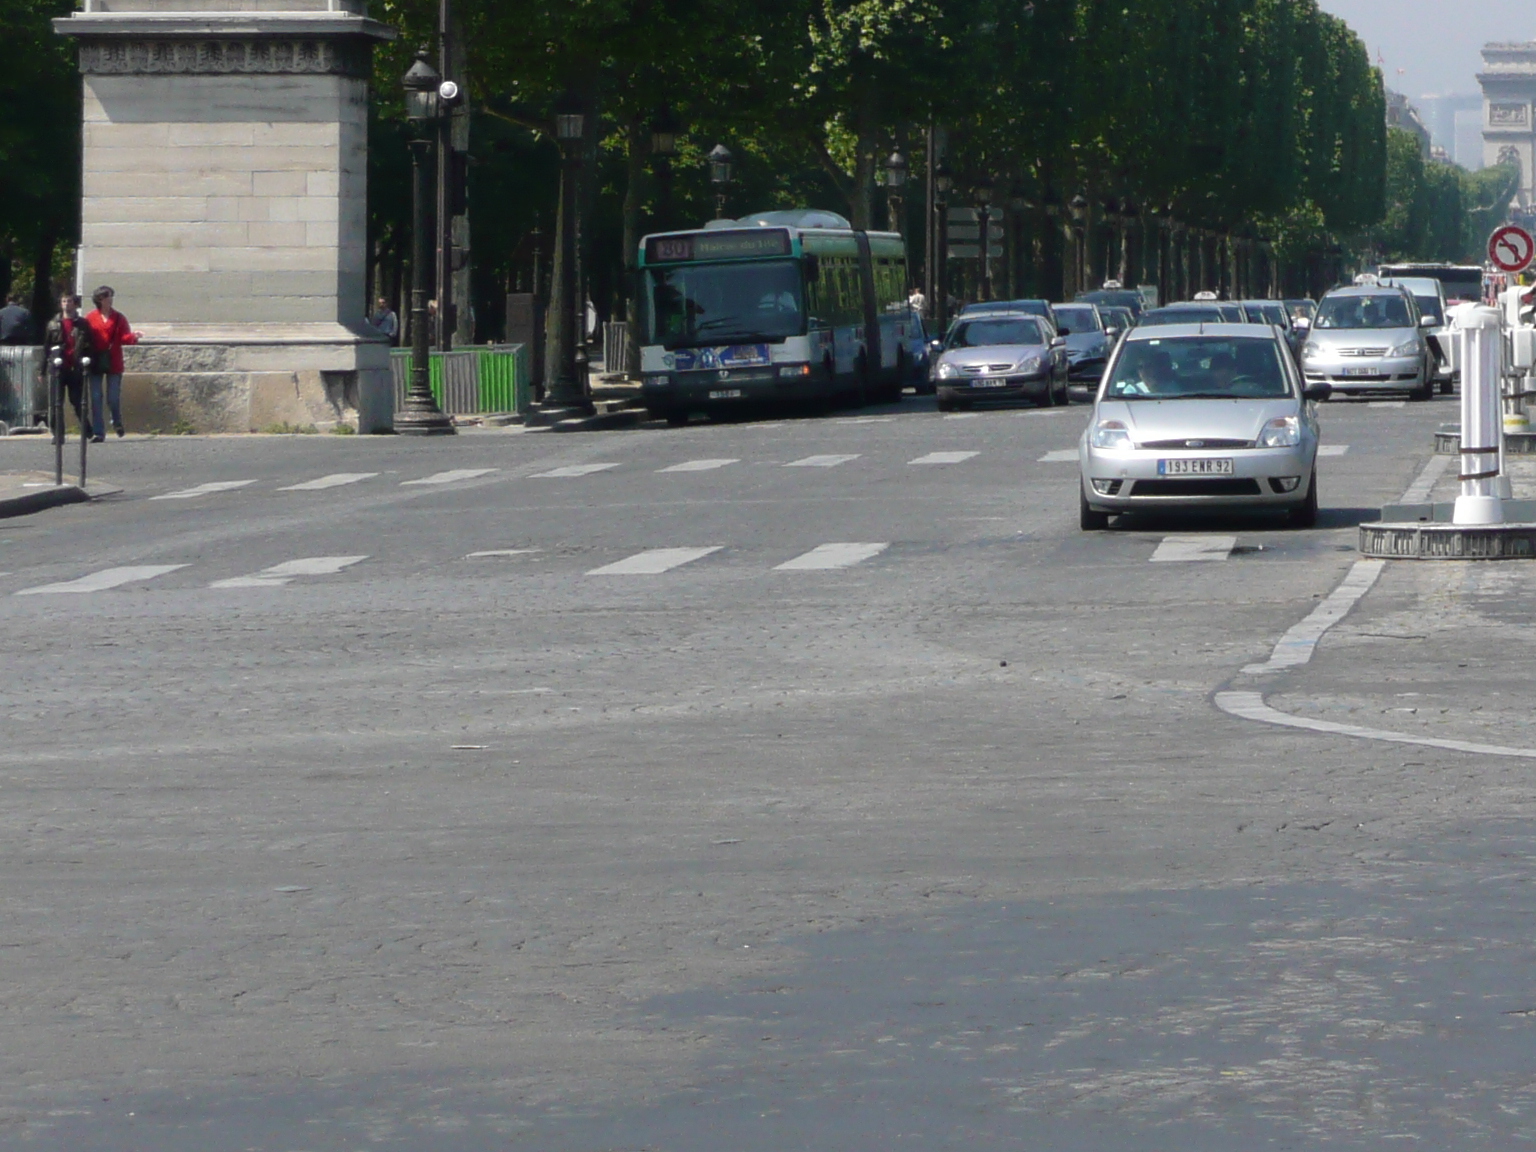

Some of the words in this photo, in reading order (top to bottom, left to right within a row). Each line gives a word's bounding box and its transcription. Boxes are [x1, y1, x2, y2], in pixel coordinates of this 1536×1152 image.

[1168, 459, 1188, 473] 193
[1192, 459, 1212, 473] ENR
[1216, 459, 1230, 473] 92
